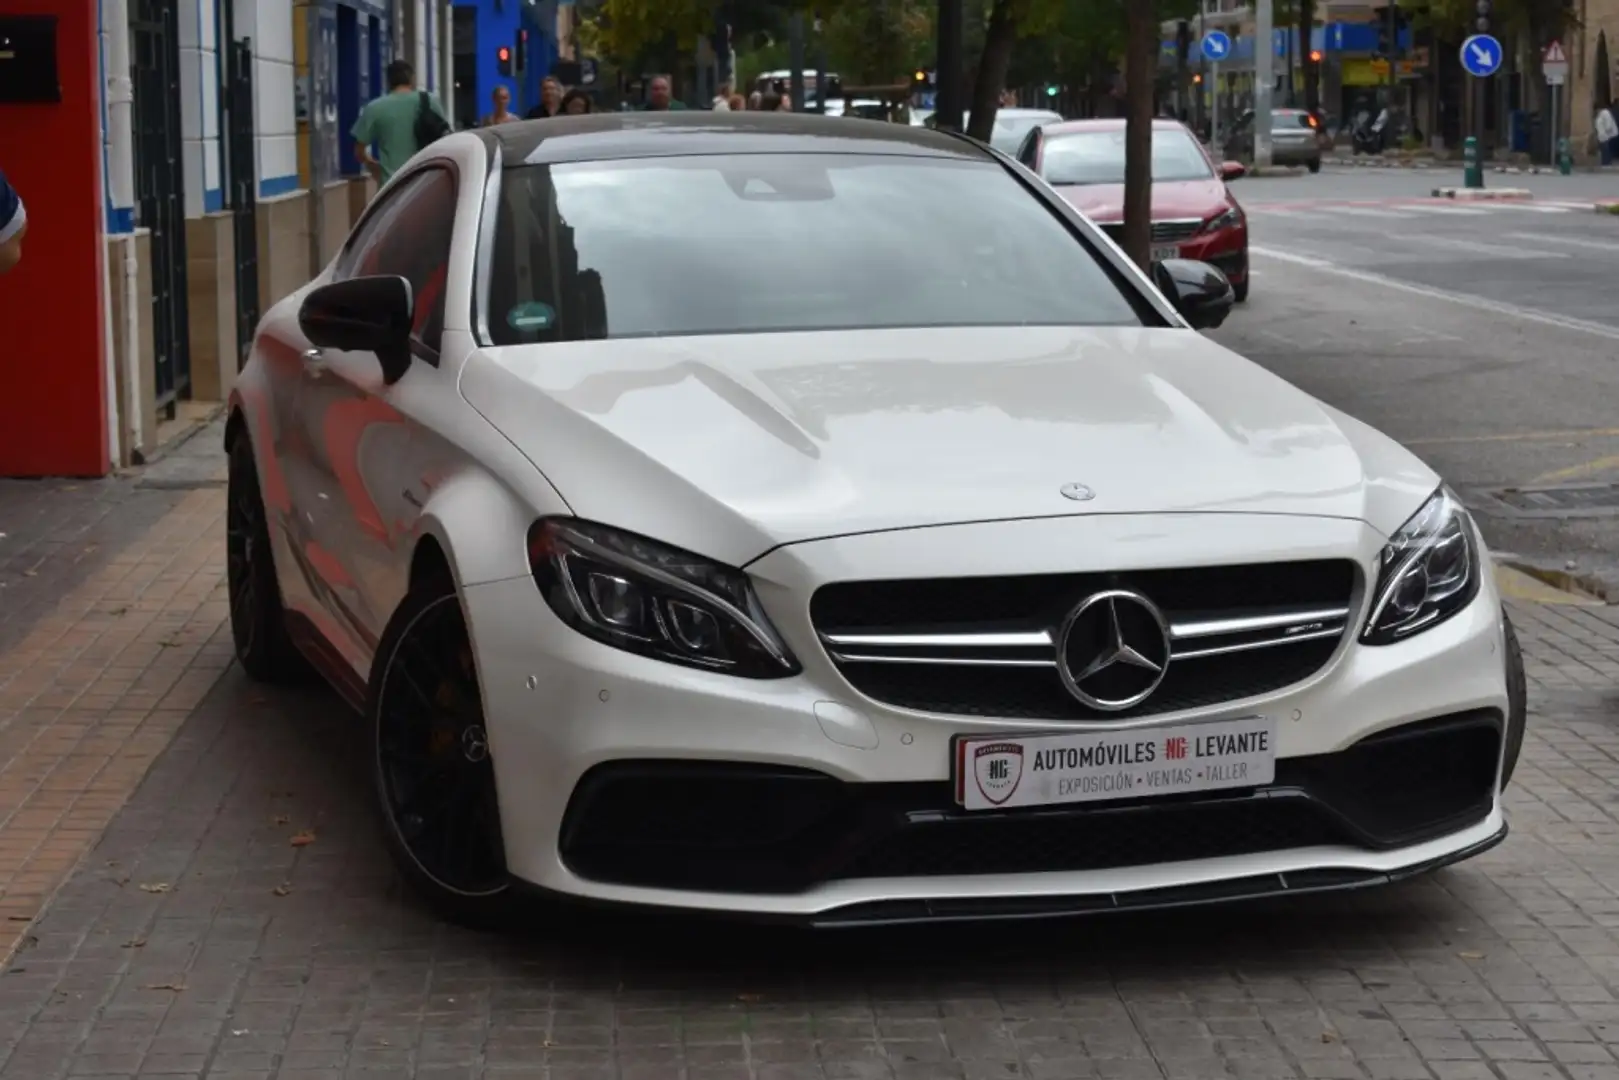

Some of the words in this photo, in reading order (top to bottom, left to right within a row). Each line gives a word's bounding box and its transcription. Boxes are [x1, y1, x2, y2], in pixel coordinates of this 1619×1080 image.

[1033, 741, 1156, 771] AUTOMÓVILES
[1196, 730, 1269, 758] LEVANTE
[1059, 771, 1132, 795] EXPOSICIÓN
[1146, 768, 1192, 787] VENTAS
[1205, 762, 1248, 781] TALLER
